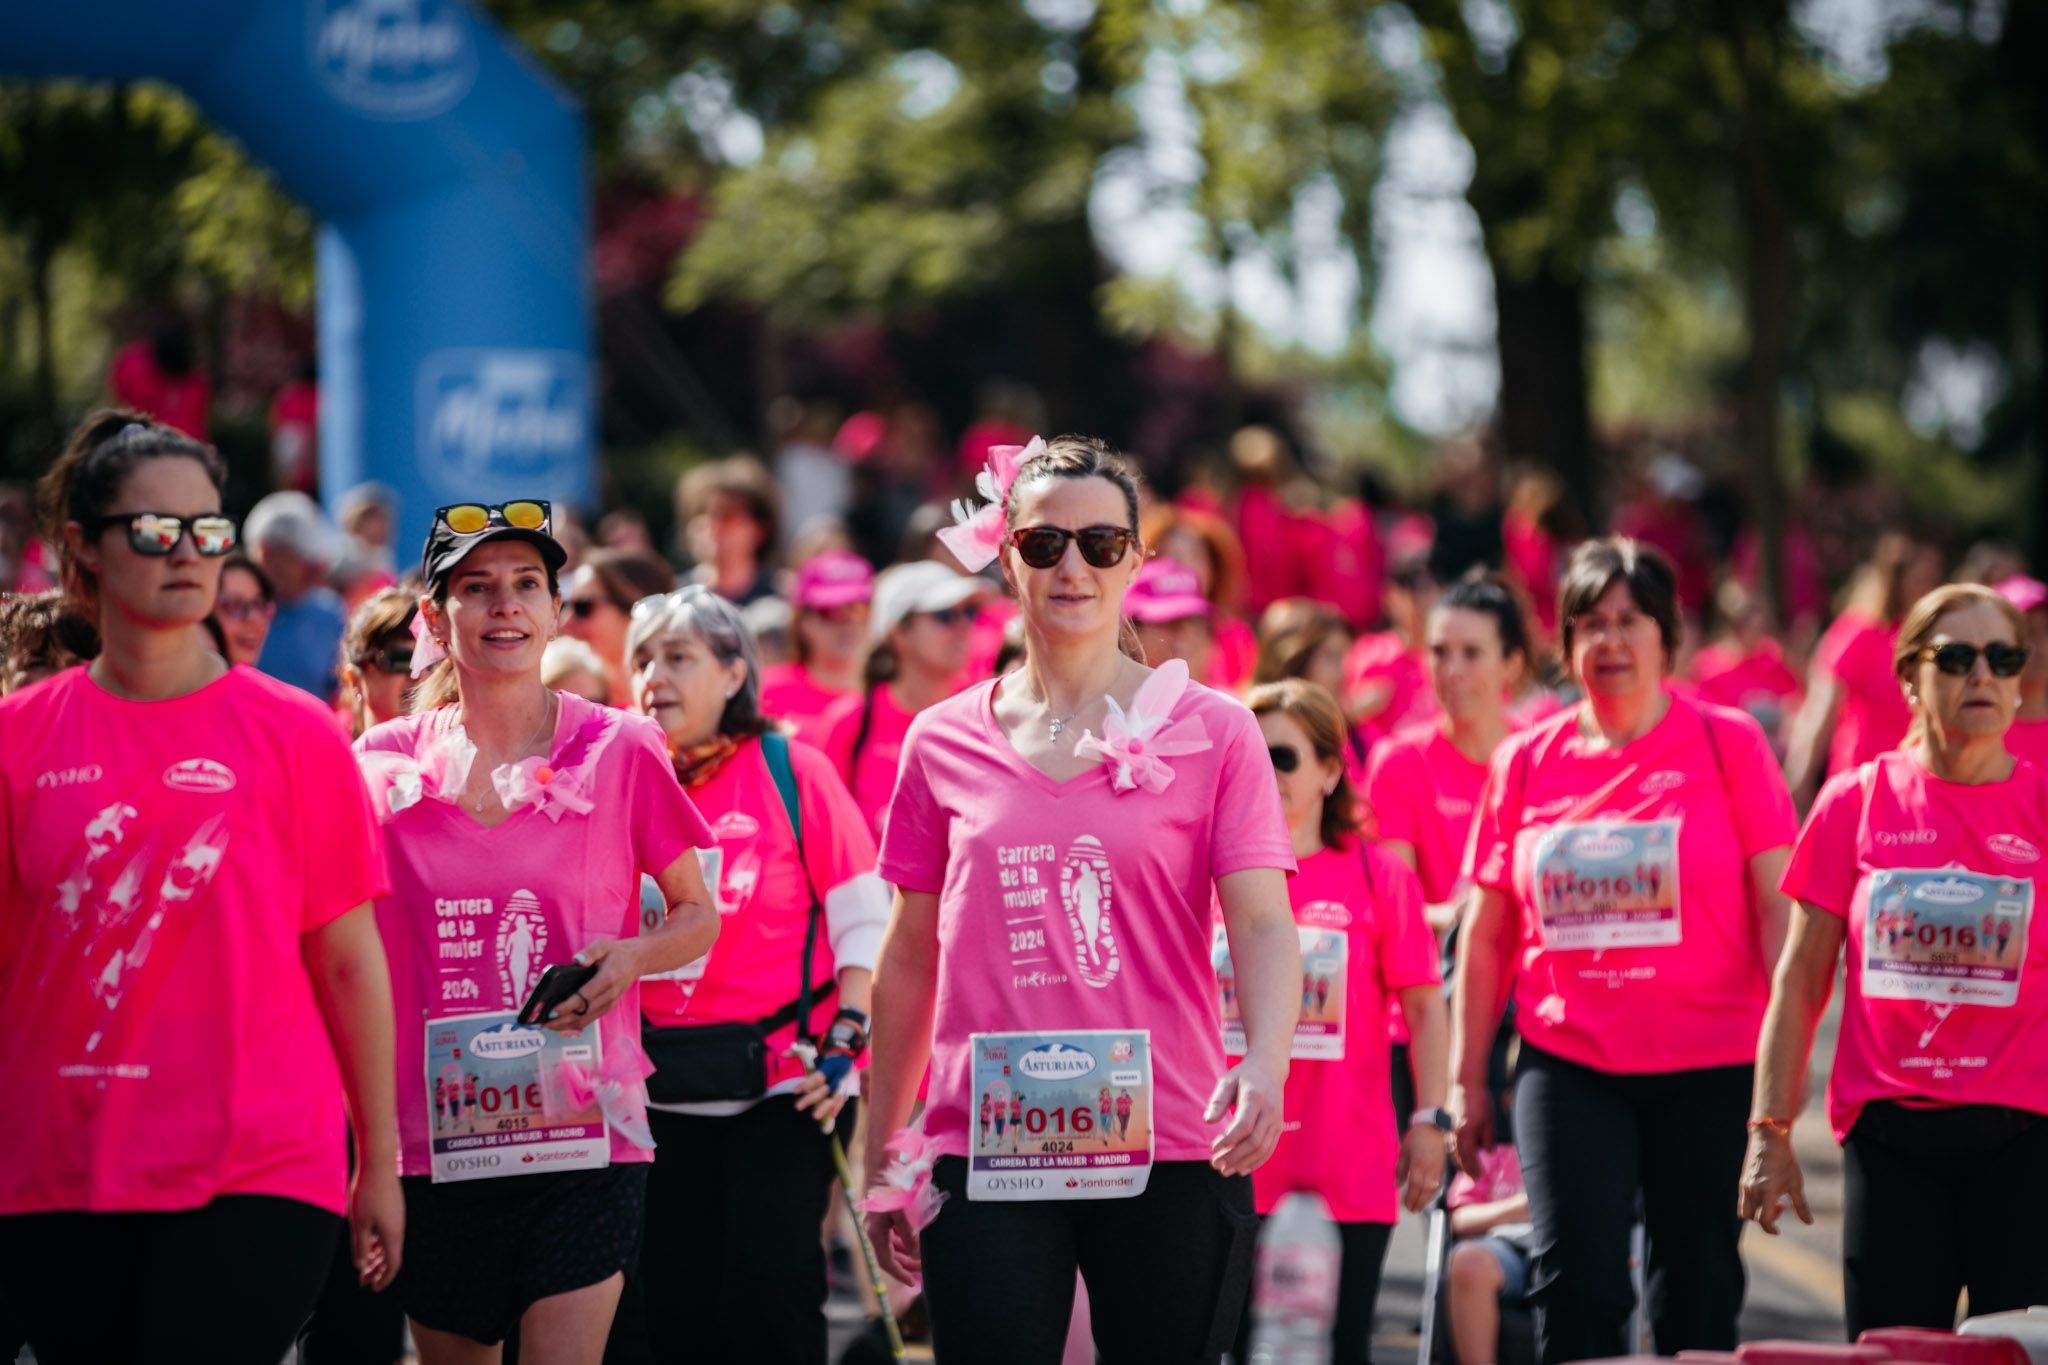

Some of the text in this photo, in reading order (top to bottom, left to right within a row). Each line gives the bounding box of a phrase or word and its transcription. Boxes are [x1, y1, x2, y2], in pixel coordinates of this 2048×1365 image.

[997, 844, 1056, 865] Carrera
[1000, 865, 1038, 887] de la
[1579, 876, 1633, 898] 016
[435, 898, 494, 917] Carrera
[1003, 887, 1048, 909] mujer
[437, 919, 476, 938] de la
[1917, 923, 1977, 948] 016
[439, 938, 485, 959] mujer
[1009, 928, 1046, 953] 2024
[441, 978, 479, 1000] 2024
[474, 1038, 541, 1053] ASTURIANA
[1023, 1057, 1090, 1072] ASTURIANA
[480, 1083, 543, 1112] 016
[497, 1117, 529, 1130] 4015
[1025, 1107, 1094, 1134] 016
[446, 1136, 484, 1149] CARRERA
[486, 1135, 498, 1145] DE
[499, 1134, 511, 1145] LA
[512, 1130, 543, 1143] MUJER
[549, 1127, 586, 1140] MADRID
[1041, 1140, 1074, 1153] 4024
[447, 1154, 501, 1172] OYSHO
[989, 1157, 1028, 1168] CARRERA
[1029, 1156, 1043, 1167] DE
[1044, 1156, 1055, 1167] LA
[1057, 1155, 1088, 1166] MUJER
[1095, 1154, 1131, 1165] MADRID
[987, 1176, 1044, 1190] OYSHO
[1080, 1176, 1135, 1189] Santander
